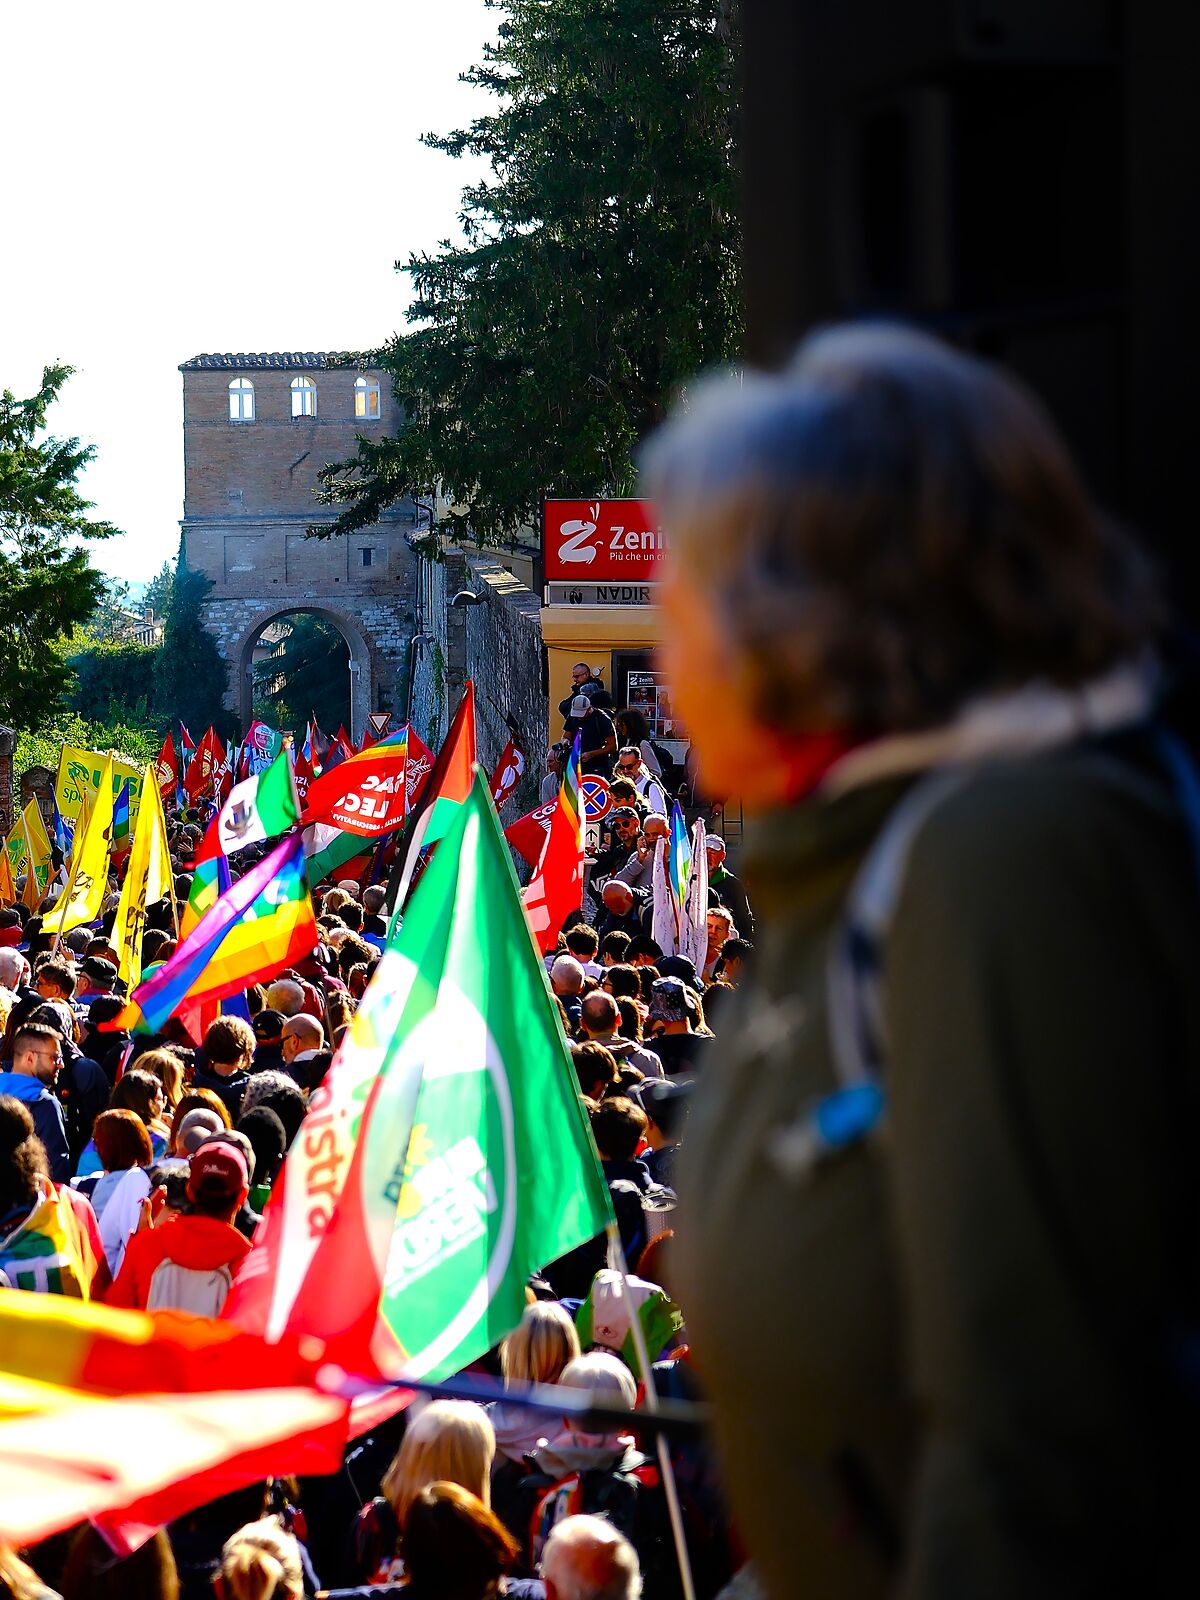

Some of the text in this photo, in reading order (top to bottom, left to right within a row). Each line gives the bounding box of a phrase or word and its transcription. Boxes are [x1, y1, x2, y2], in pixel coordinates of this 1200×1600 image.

[609, 526, 669, 550] Zeni
[625, 552, 641, 561] che
[643, 553, 655, 561] un
